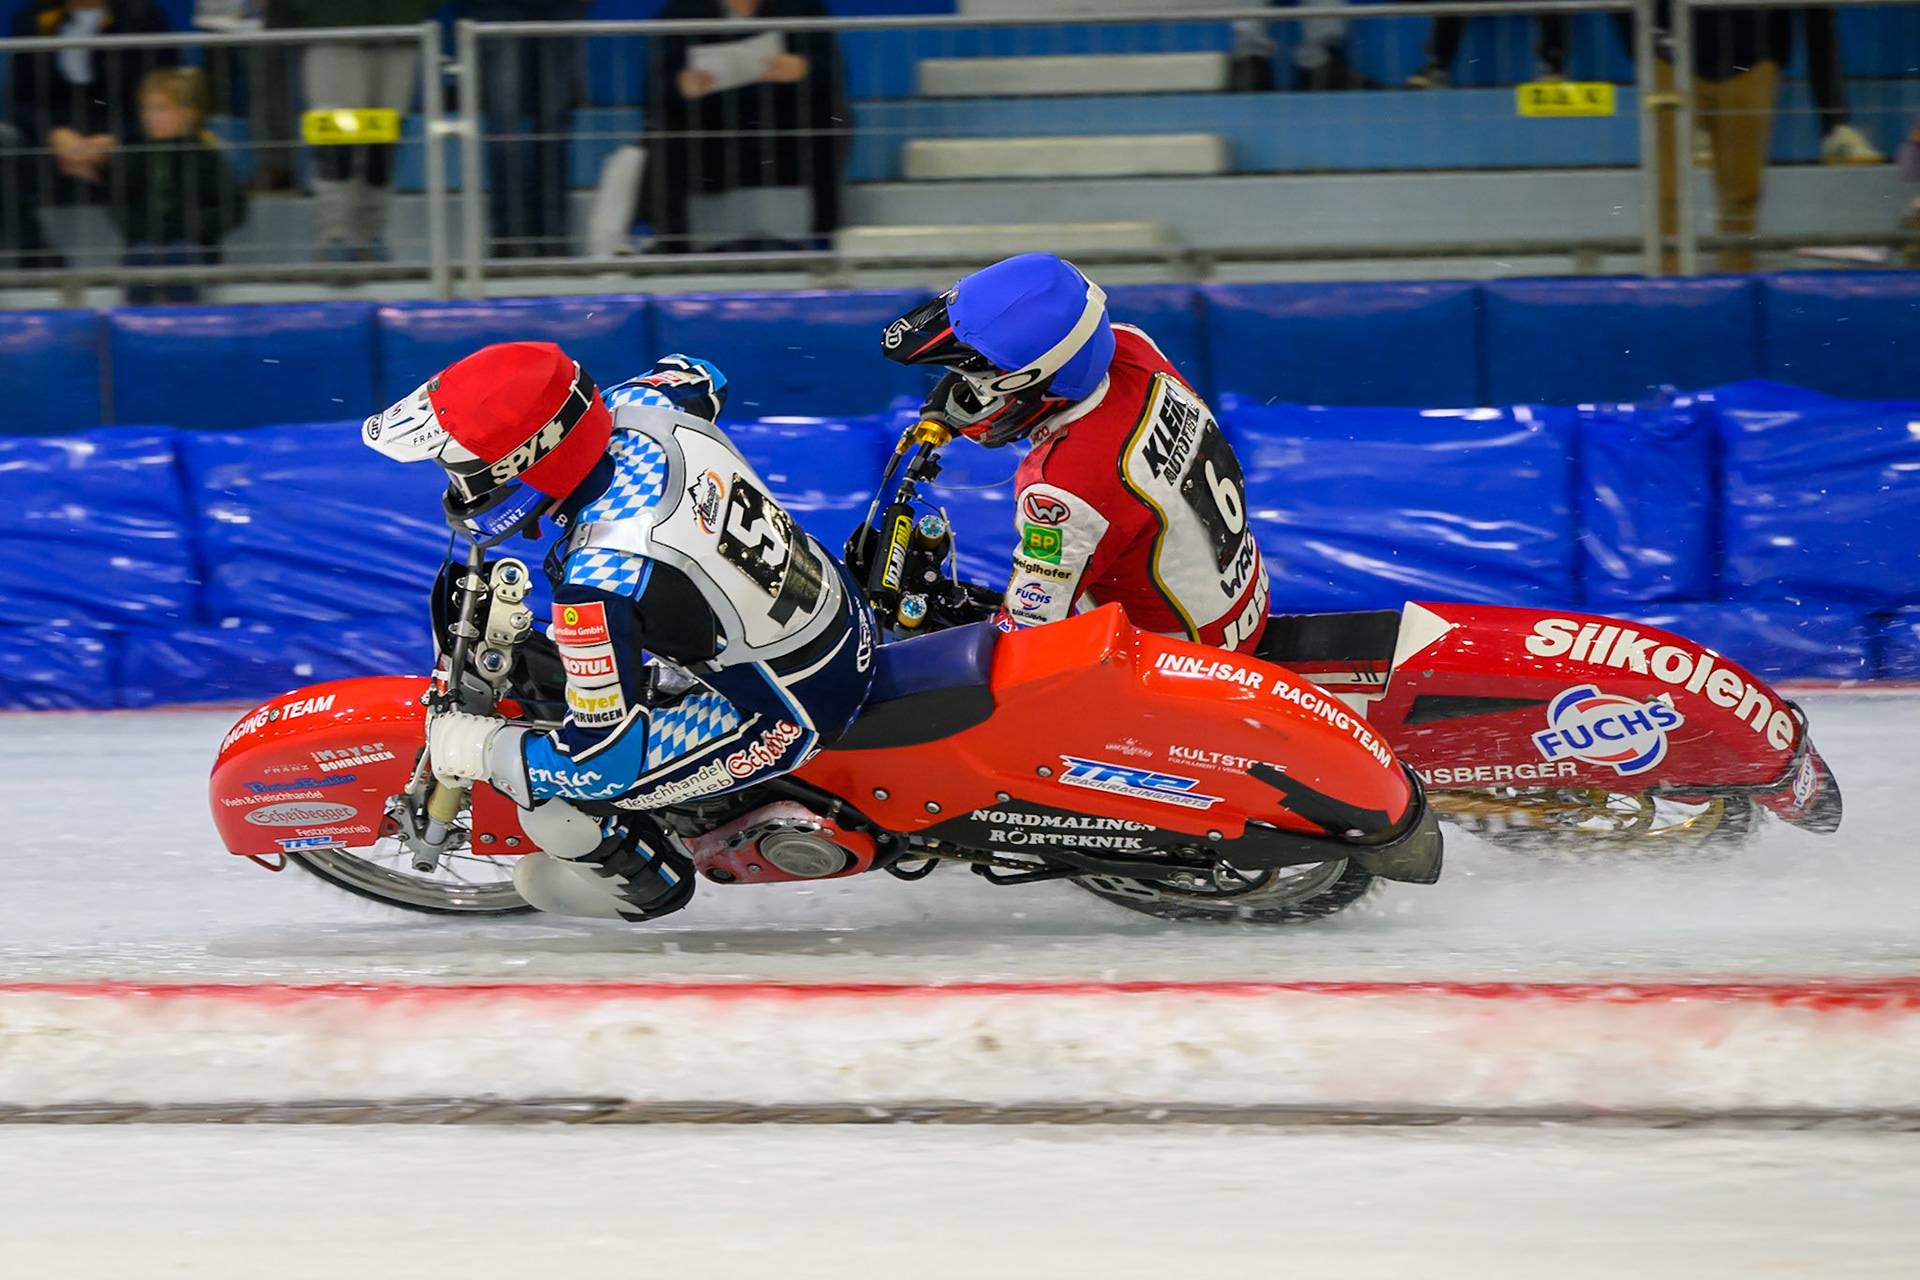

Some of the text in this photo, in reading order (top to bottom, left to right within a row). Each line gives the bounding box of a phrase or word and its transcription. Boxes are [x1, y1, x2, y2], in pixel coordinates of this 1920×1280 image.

[1205, 460, 1243, 534] 6
[490, 508, 526, 534] FRANZ
[726, 501, 786, 567] 5
[1031, 533, 1055, 550] BP
[1015, 587, 1052, 604] FUCHS
[578, 625, 604, 636] GmbH
[568, 687, 619, 712] Mayer
[1154, 653, 1391, 768] INN-ISAR RACING TEAM
[221, 694, 336, 753] RACING TEAM
[1537, 704, 1677, 757] FUCHS
[317, 742, 384, 762] Mayer
[319, 750, 395, 773] BOHRUNGEN
[1168, 745, 1288, 773] KULTSTF
[255, 790, 325, 803] Fleischhandel
[617, 762, 725, 809] Fleischhandel
[1061, 776, 1211, 809] TRACKRACINGPARTS
[250, 806, 353, 823] Scheibegger
[295, 825, 371, 837] Festzeltbetrieb
[988, 827, 1143, 849] RÖRTEKNIK
